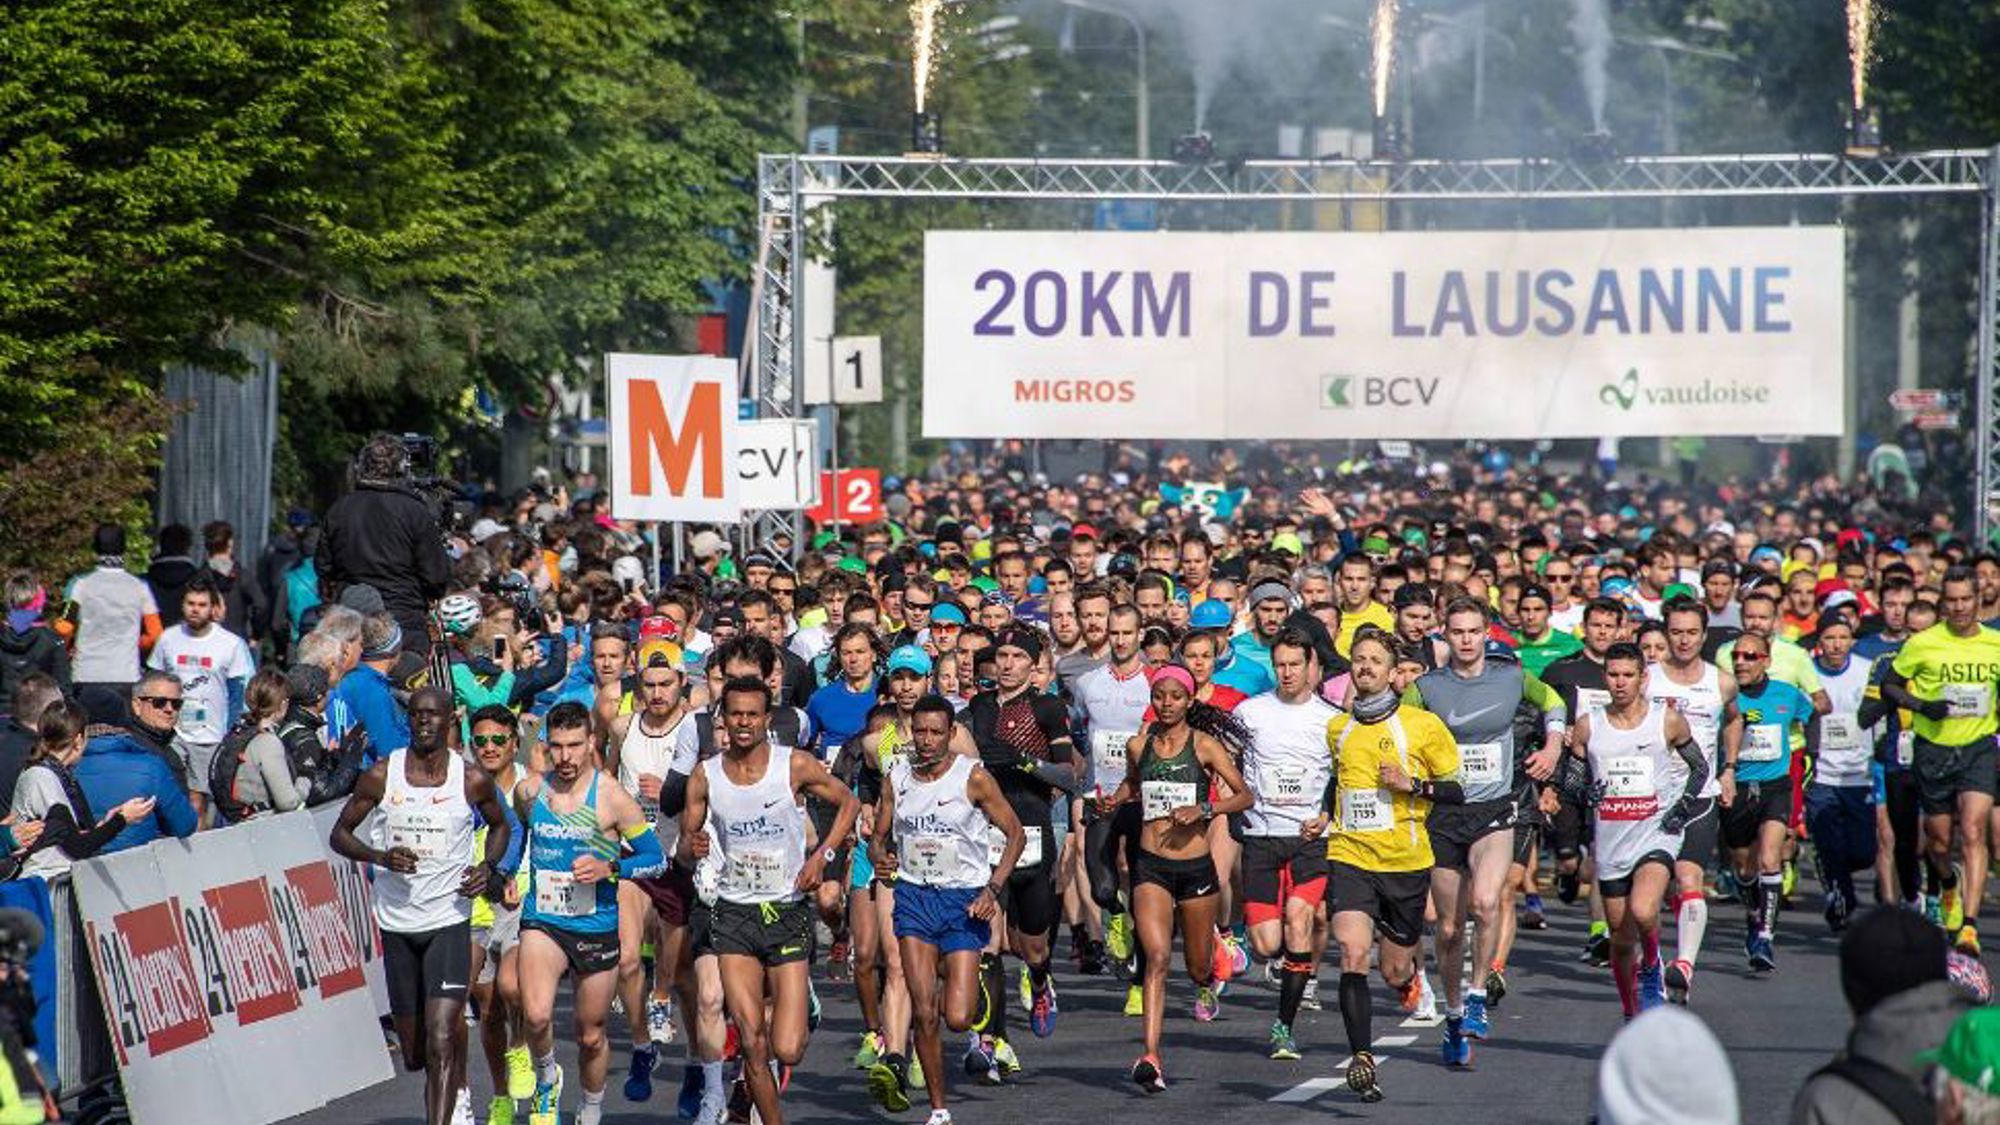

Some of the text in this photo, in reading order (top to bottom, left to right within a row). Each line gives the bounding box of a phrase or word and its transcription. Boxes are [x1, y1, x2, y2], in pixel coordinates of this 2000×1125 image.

[973, 267, 1792, 337] 20KM DE LAUSANNE
[844, 351, 863, 390] 1
[1014, 380, 1136, 402] MIGROS
[1364, 377, 1439, 406] BCV
[1645, 378, 1770, 405] vaudoise
[628, 378, 724, 499] M
[846, 478, 873, 513] 2
[1939, 662, 1999, 683] ASICS
[1278, 785, 1302, 794] 1109
